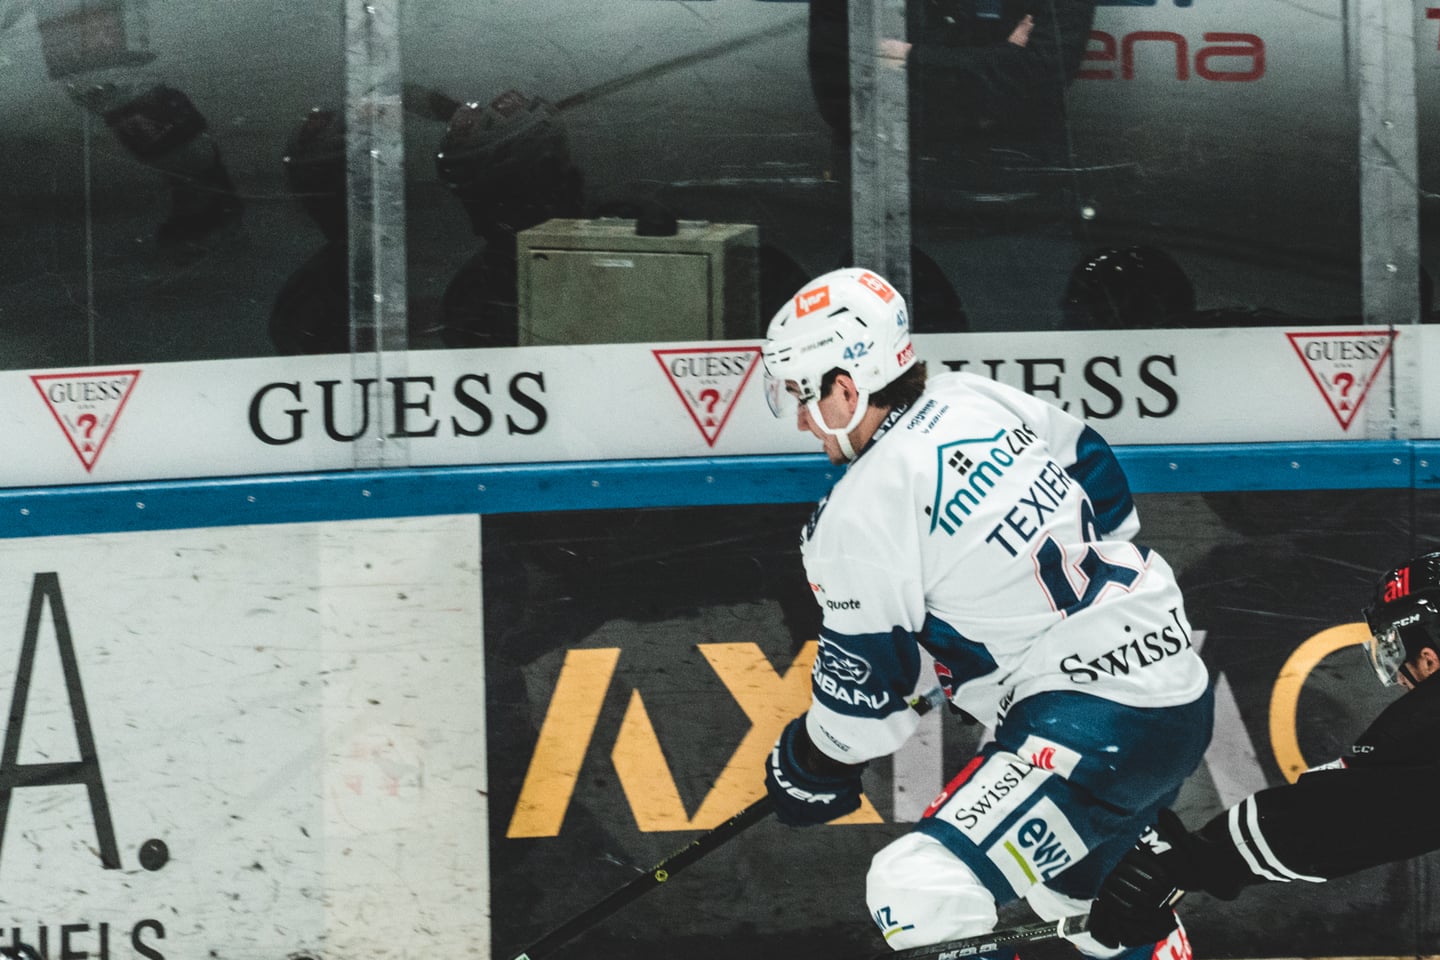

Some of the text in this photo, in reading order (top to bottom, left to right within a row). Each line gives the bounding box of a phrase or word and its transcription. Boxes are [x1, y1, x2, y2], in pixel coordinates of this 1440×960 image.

[842, 341, 869, 361] 42
[1304, 340, 1380, 361] GUESS
[671, 356, 745, 378] GUESS
[49, 380, 122, 403] GUESS
[941, 354, 1180, 420] ESS
[247, 371, 550, 446] GUESS
[985, 460, 1073, 558] TEXIER
[1383, 566, 1411, 602] ail
[826, 598, 861, 612] quote
